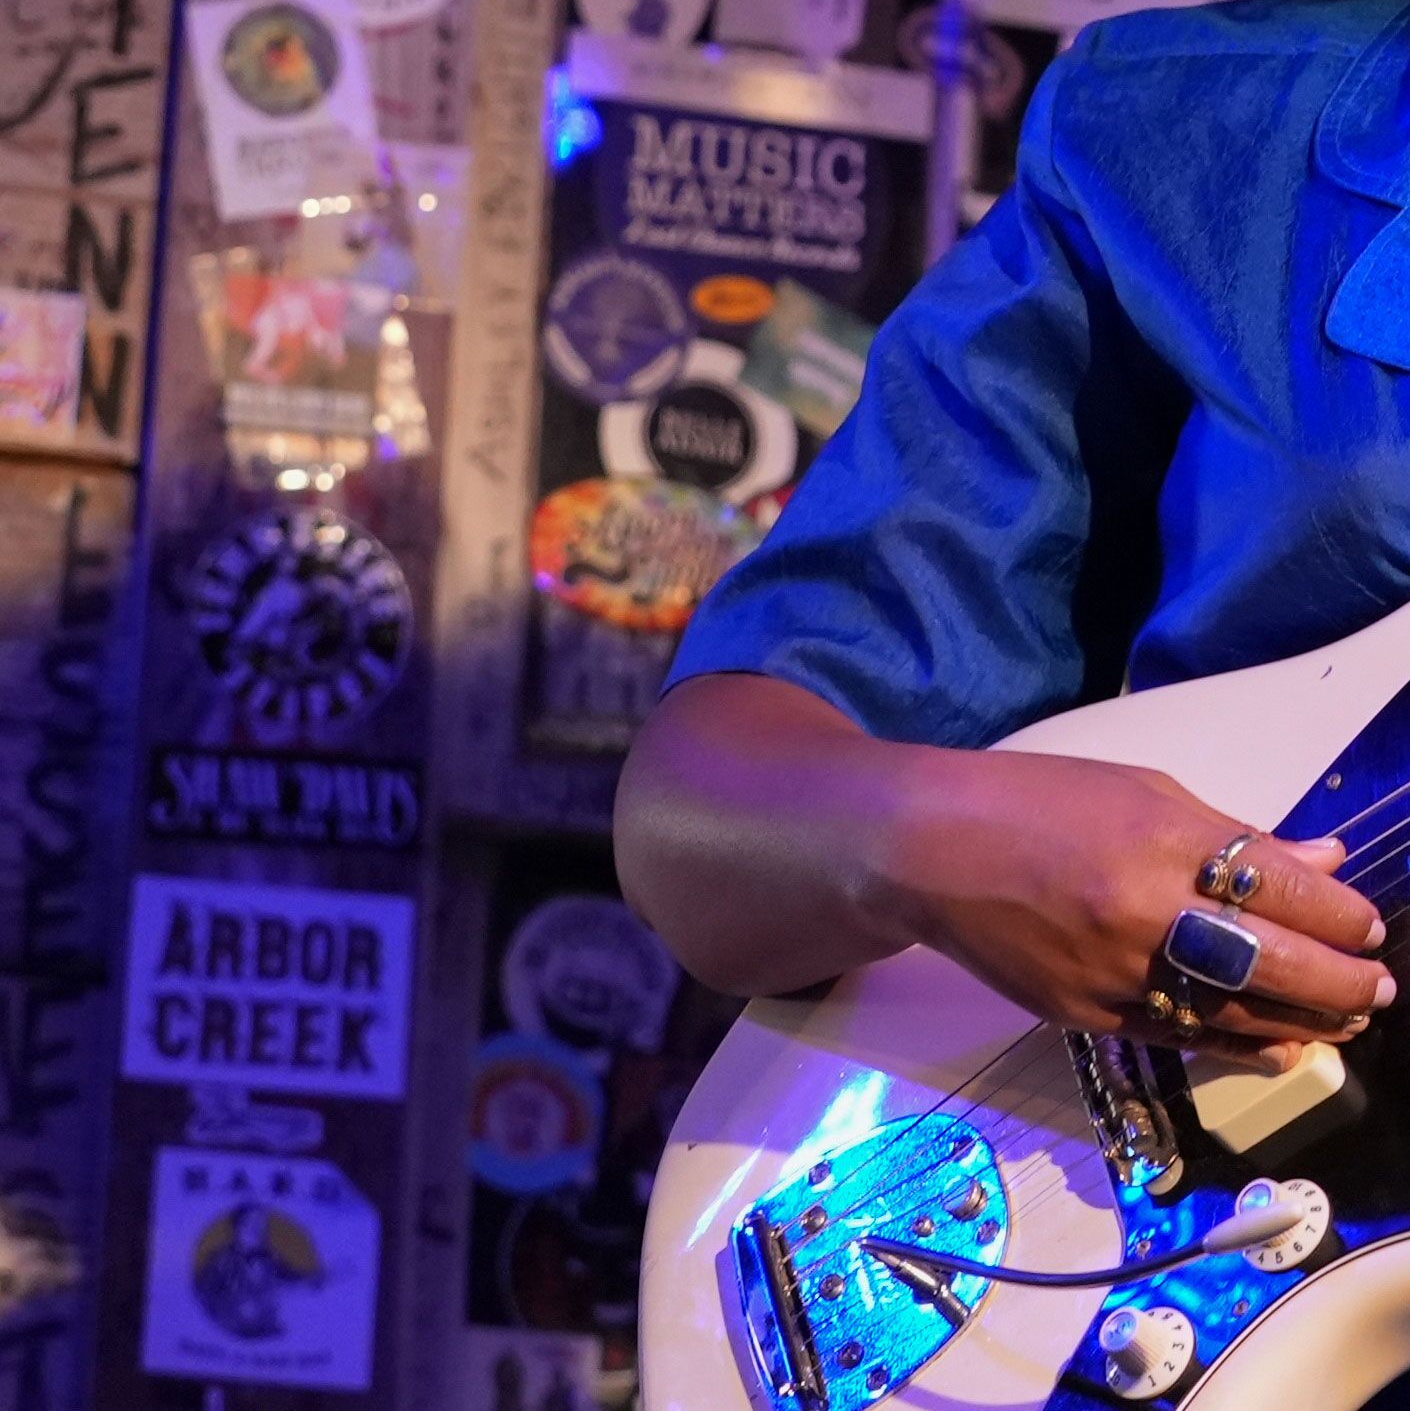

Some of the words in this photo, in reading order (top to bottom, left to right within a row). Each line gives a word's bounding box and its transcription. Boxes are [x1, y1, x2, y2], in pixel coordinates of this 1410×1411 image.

[632, 113, 867, 200] MUSIC
[626, 172, 867, 246] MATTERS
[158, 900, 385, 993] ARBOR
[151, 992, 378, 1075] CREEK
